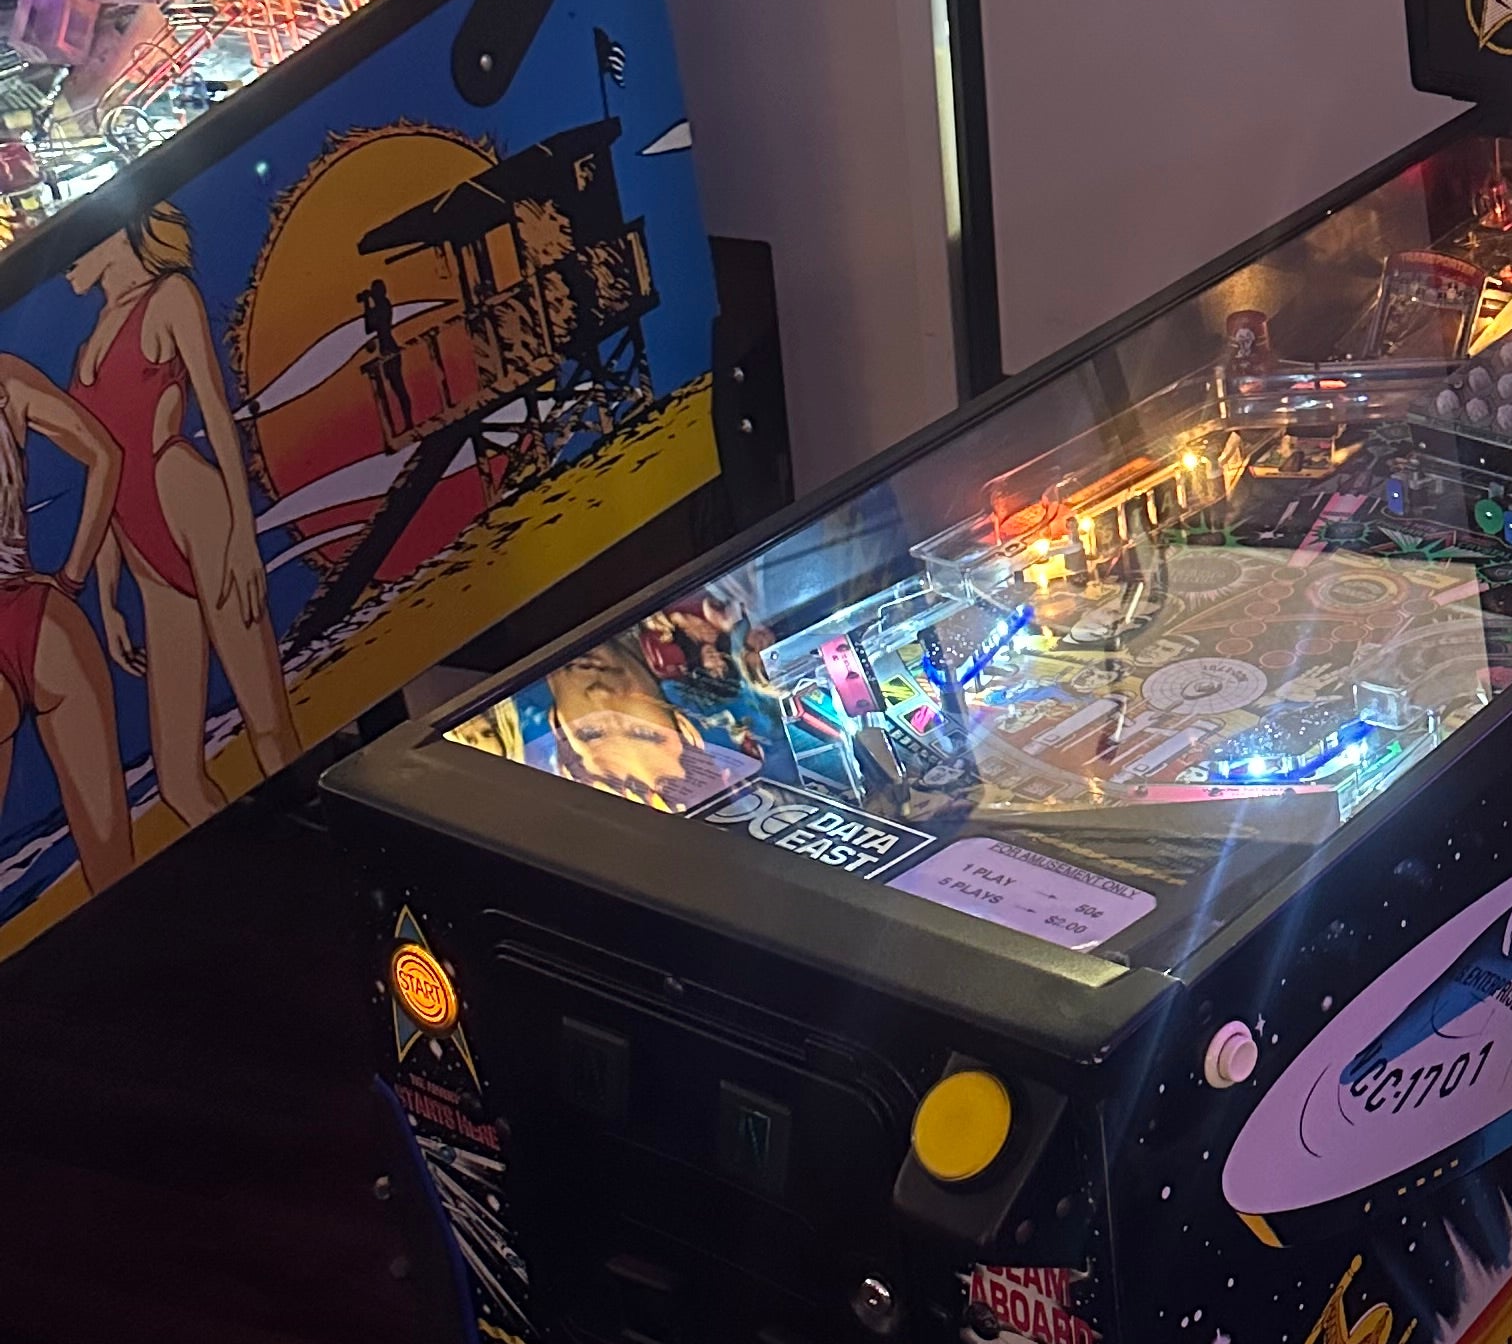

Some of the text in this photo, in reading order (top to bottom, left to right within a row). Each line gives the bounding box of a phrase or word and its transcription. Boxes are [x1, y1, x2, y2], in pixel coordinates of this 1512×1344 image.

[774, 829, 880, 875] EAST
[807, 811, 900, 856] DATA
[962, 863, 972, 873] 1
[972, 866, 1018, 888] PLAY
[1018, 850, 1102, 886] AMUSEMENT
[1100, 878, 1142, 900] ONLY
[938, 876, 1088, 935] 5 PLAYS $2.00
[398, 969, 442, 1005] START
